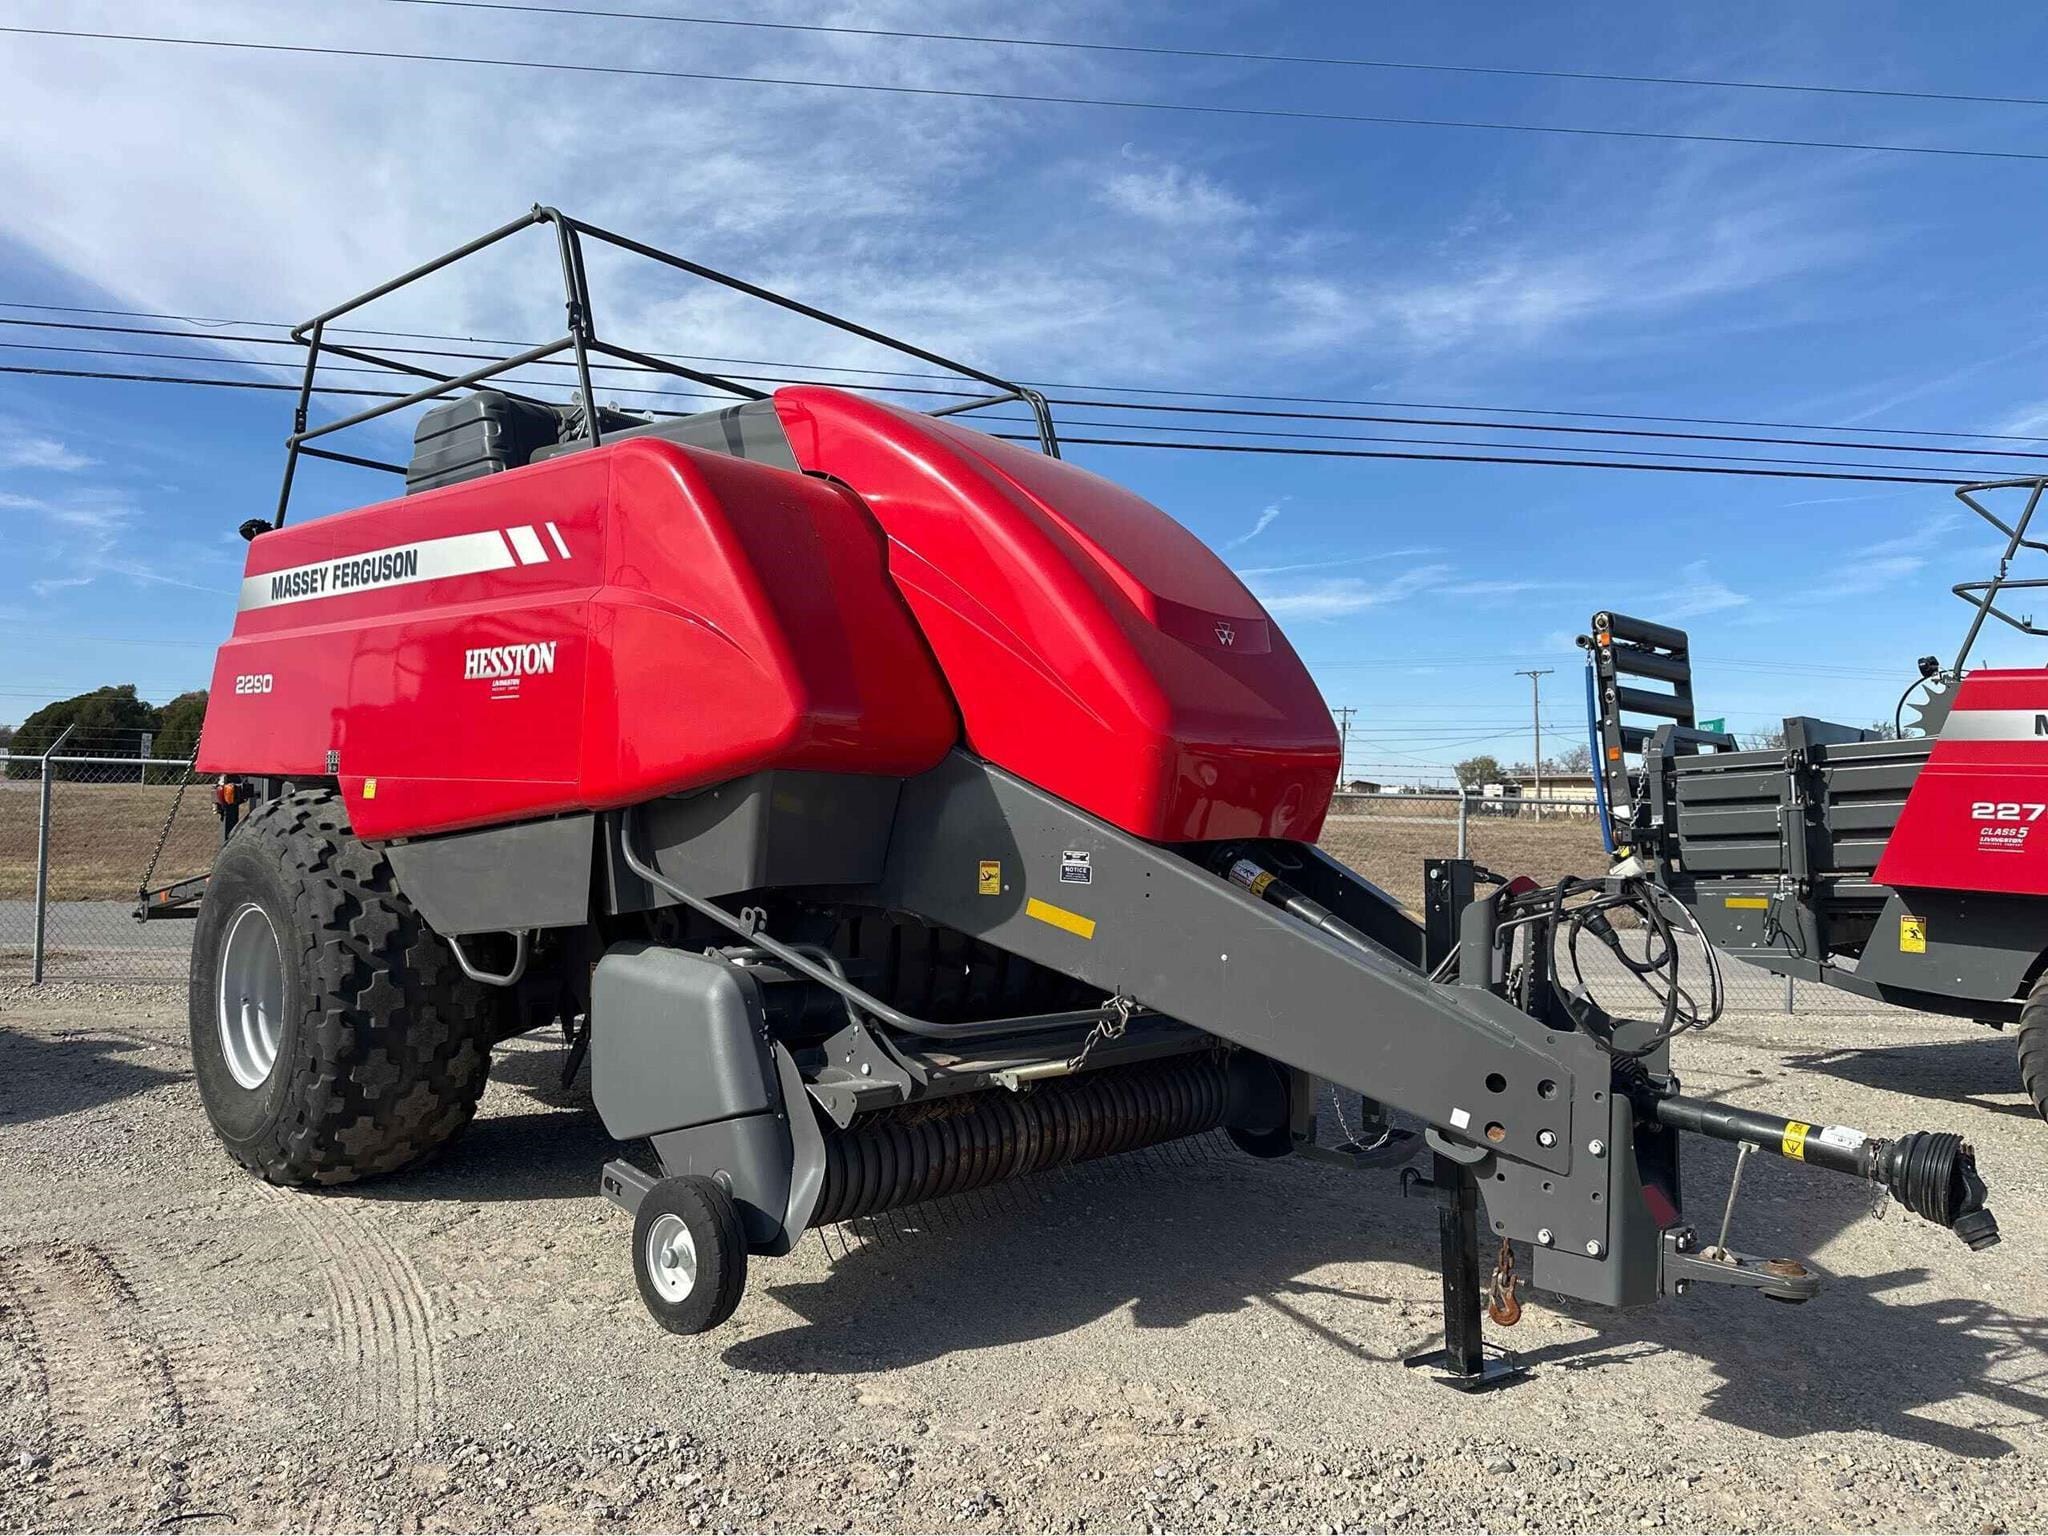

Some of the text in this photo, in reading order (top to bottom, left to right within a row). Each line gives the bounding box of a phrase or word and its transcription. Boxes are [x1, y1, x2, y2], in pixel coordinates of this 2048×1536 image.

[271, 549, 418, 600] MASSEY FERGUSON
[464, 641, 557, 680] HESSTON
[235, 673, 273, 694] 2290
[1971, 802, 2048, 821] 227
[1980, 826, 2029, 838] CLASS 5
